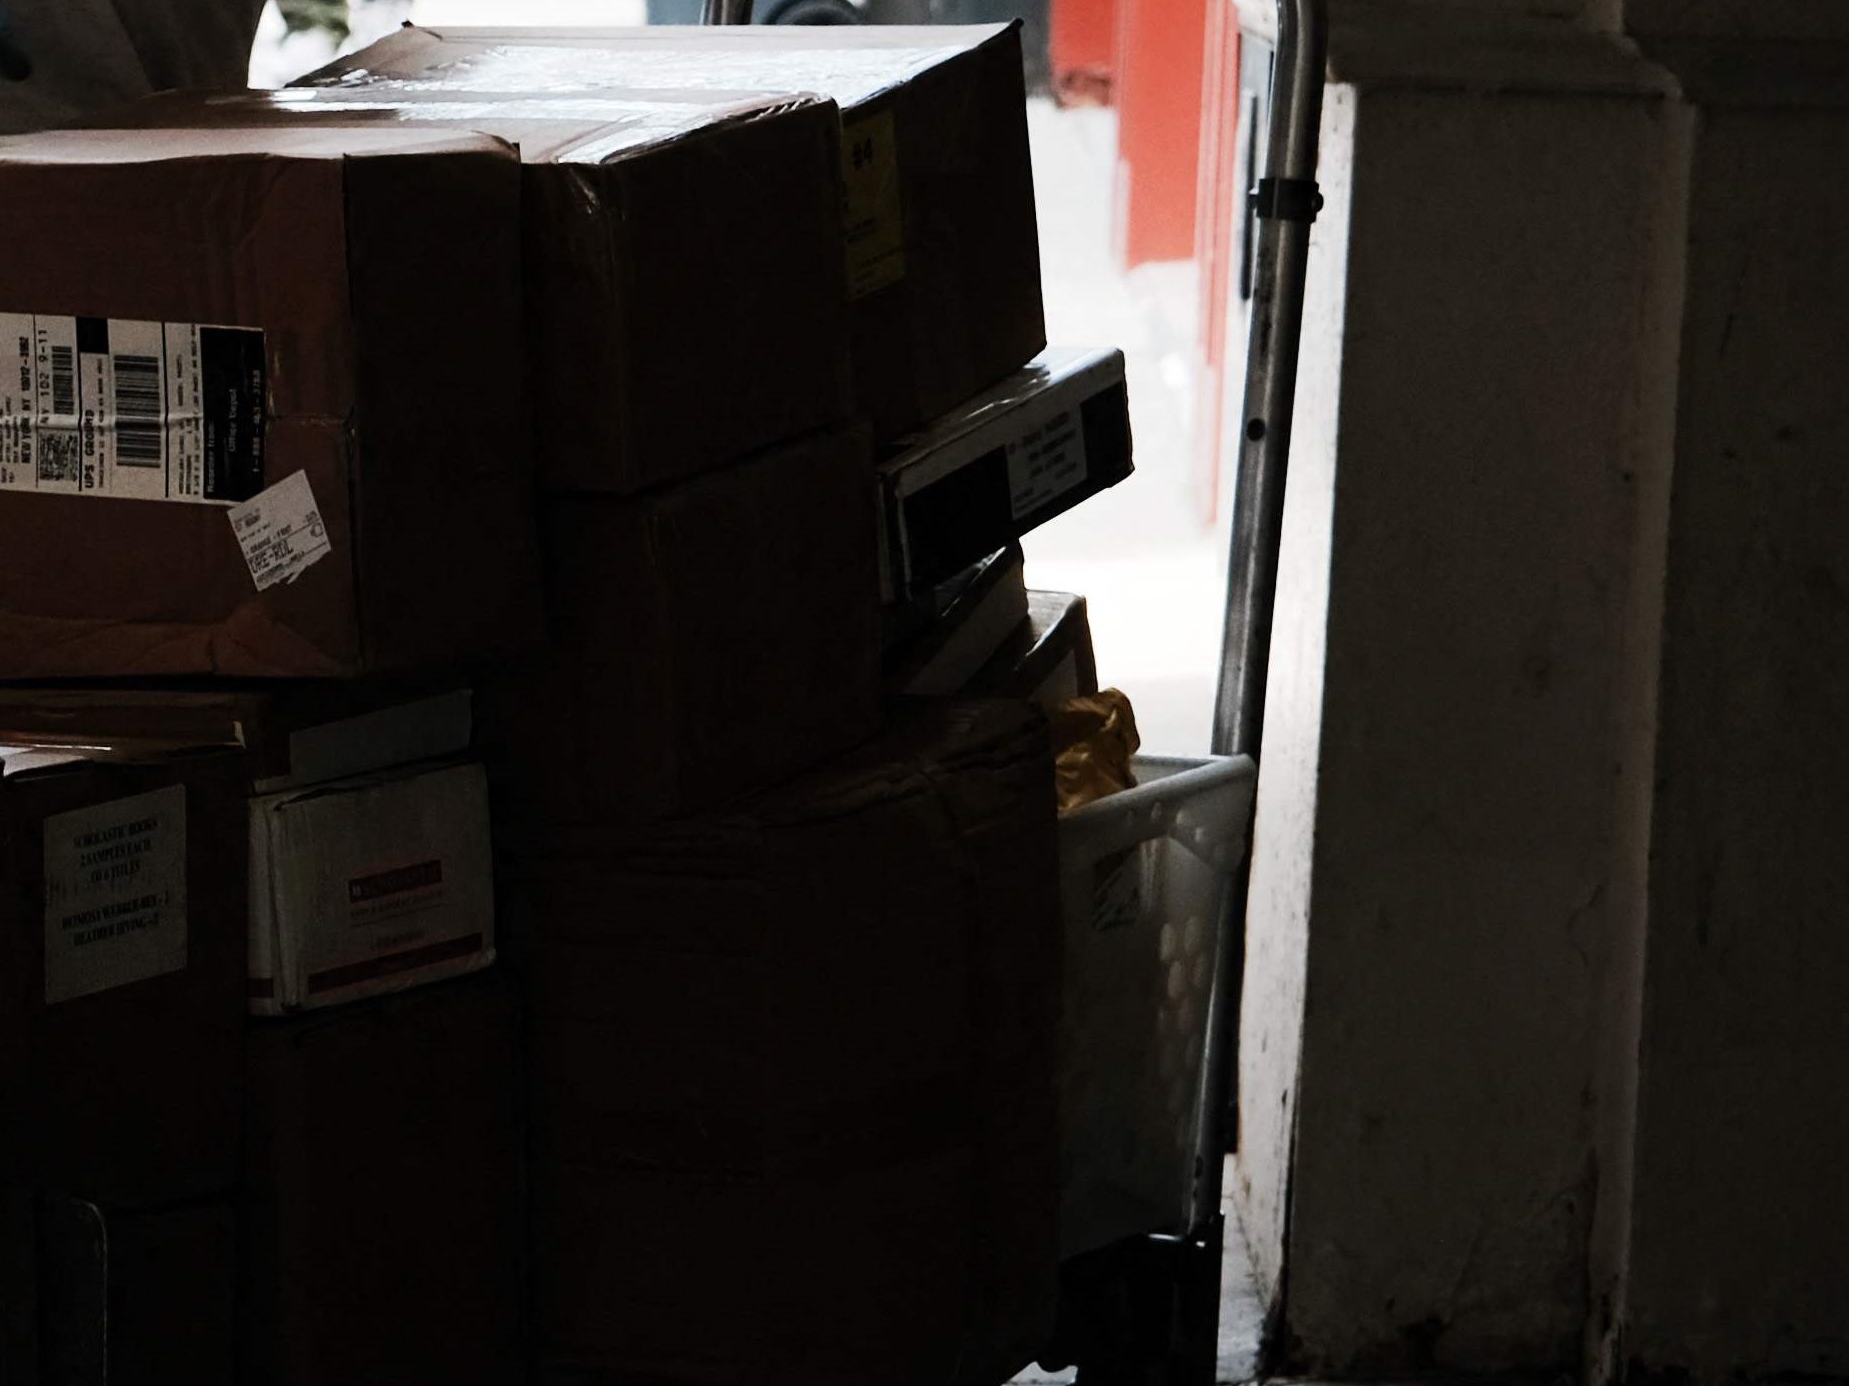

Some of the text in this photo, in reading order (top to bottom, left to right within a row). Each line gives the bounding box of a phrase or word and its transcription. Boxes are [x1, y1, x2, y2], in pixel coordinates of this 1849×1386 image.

[853, 136, 873, 171] #4
[38, 328, 50, 425] NY 102 9-11
[20, 395, 30, 411] NY
[20, 416, 30, 444] YORK
[20, 445, 31, 464] NEW
[84, 409, 95, 489] UPS GROUND
[73, 823, 127, 848] SCHOLASTIC
